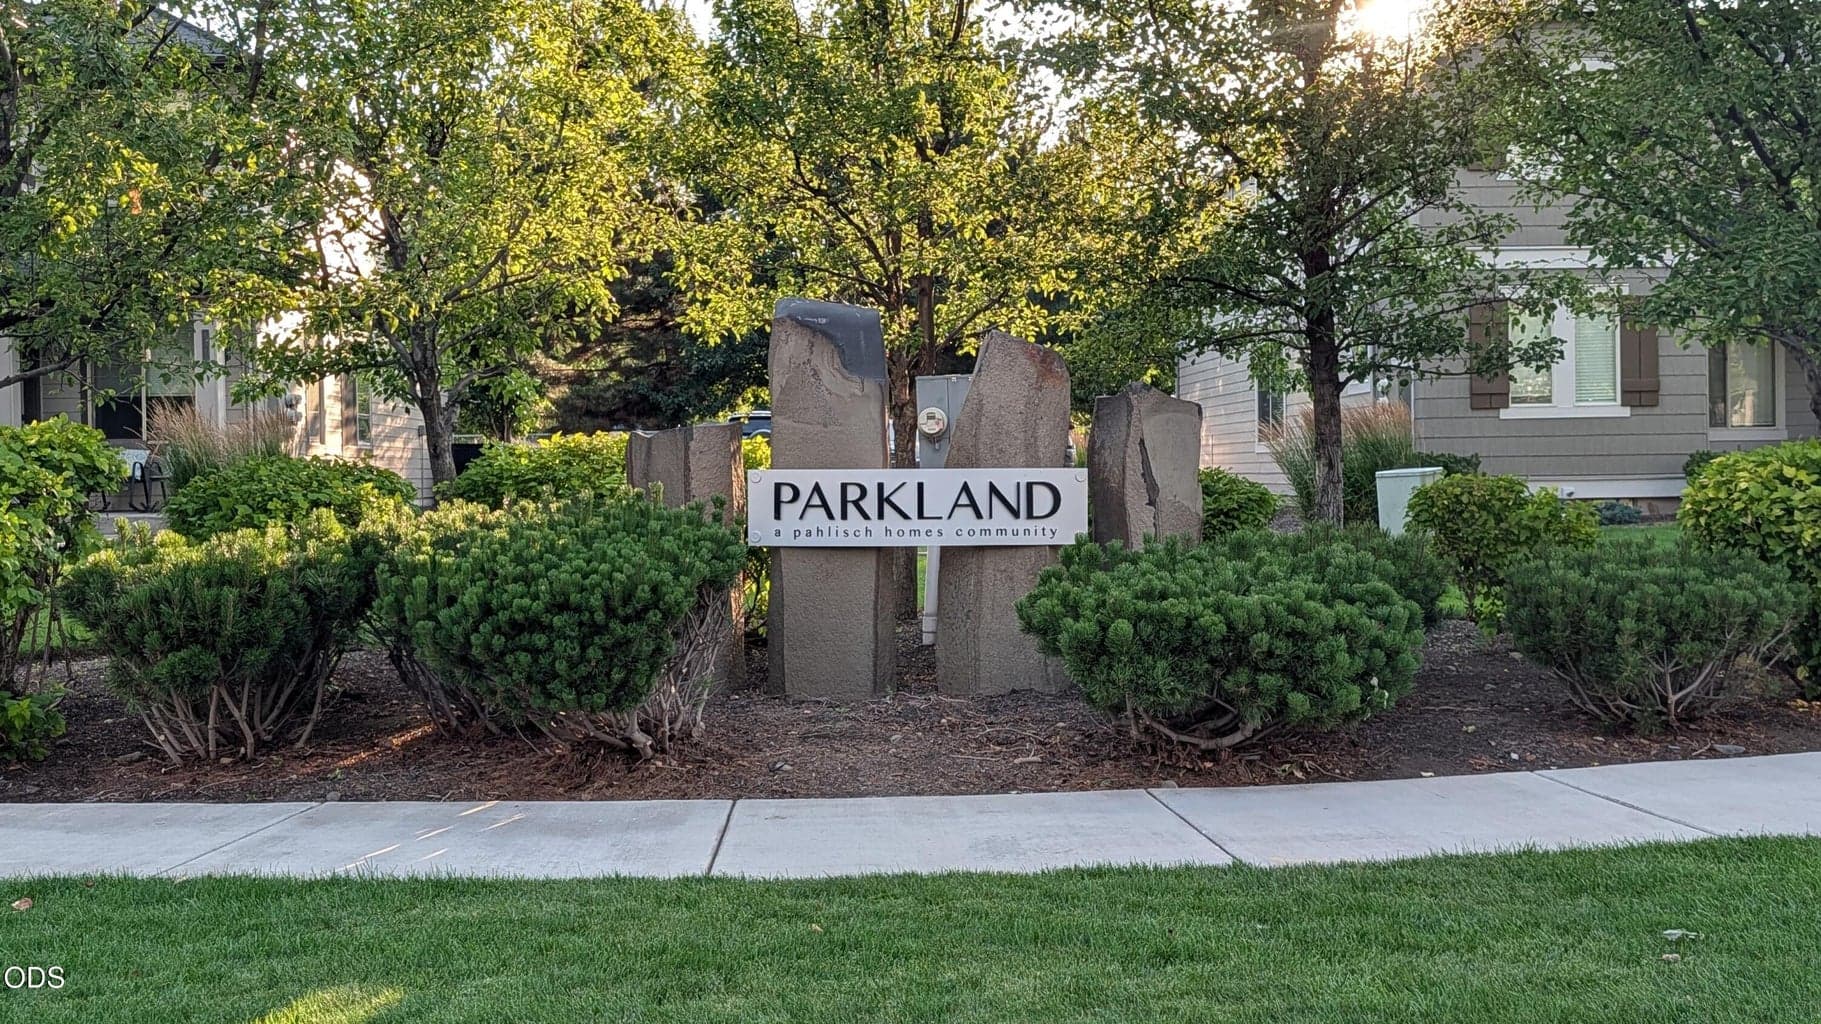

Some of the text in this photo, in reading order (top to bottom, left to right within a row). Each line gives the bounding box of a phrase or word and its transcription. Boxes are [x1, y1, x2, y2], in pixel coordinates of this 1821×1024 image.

[773, 481, 1062, 521] PARKLAND
[774, 525, 1059, 541] a pahlisch homes community
